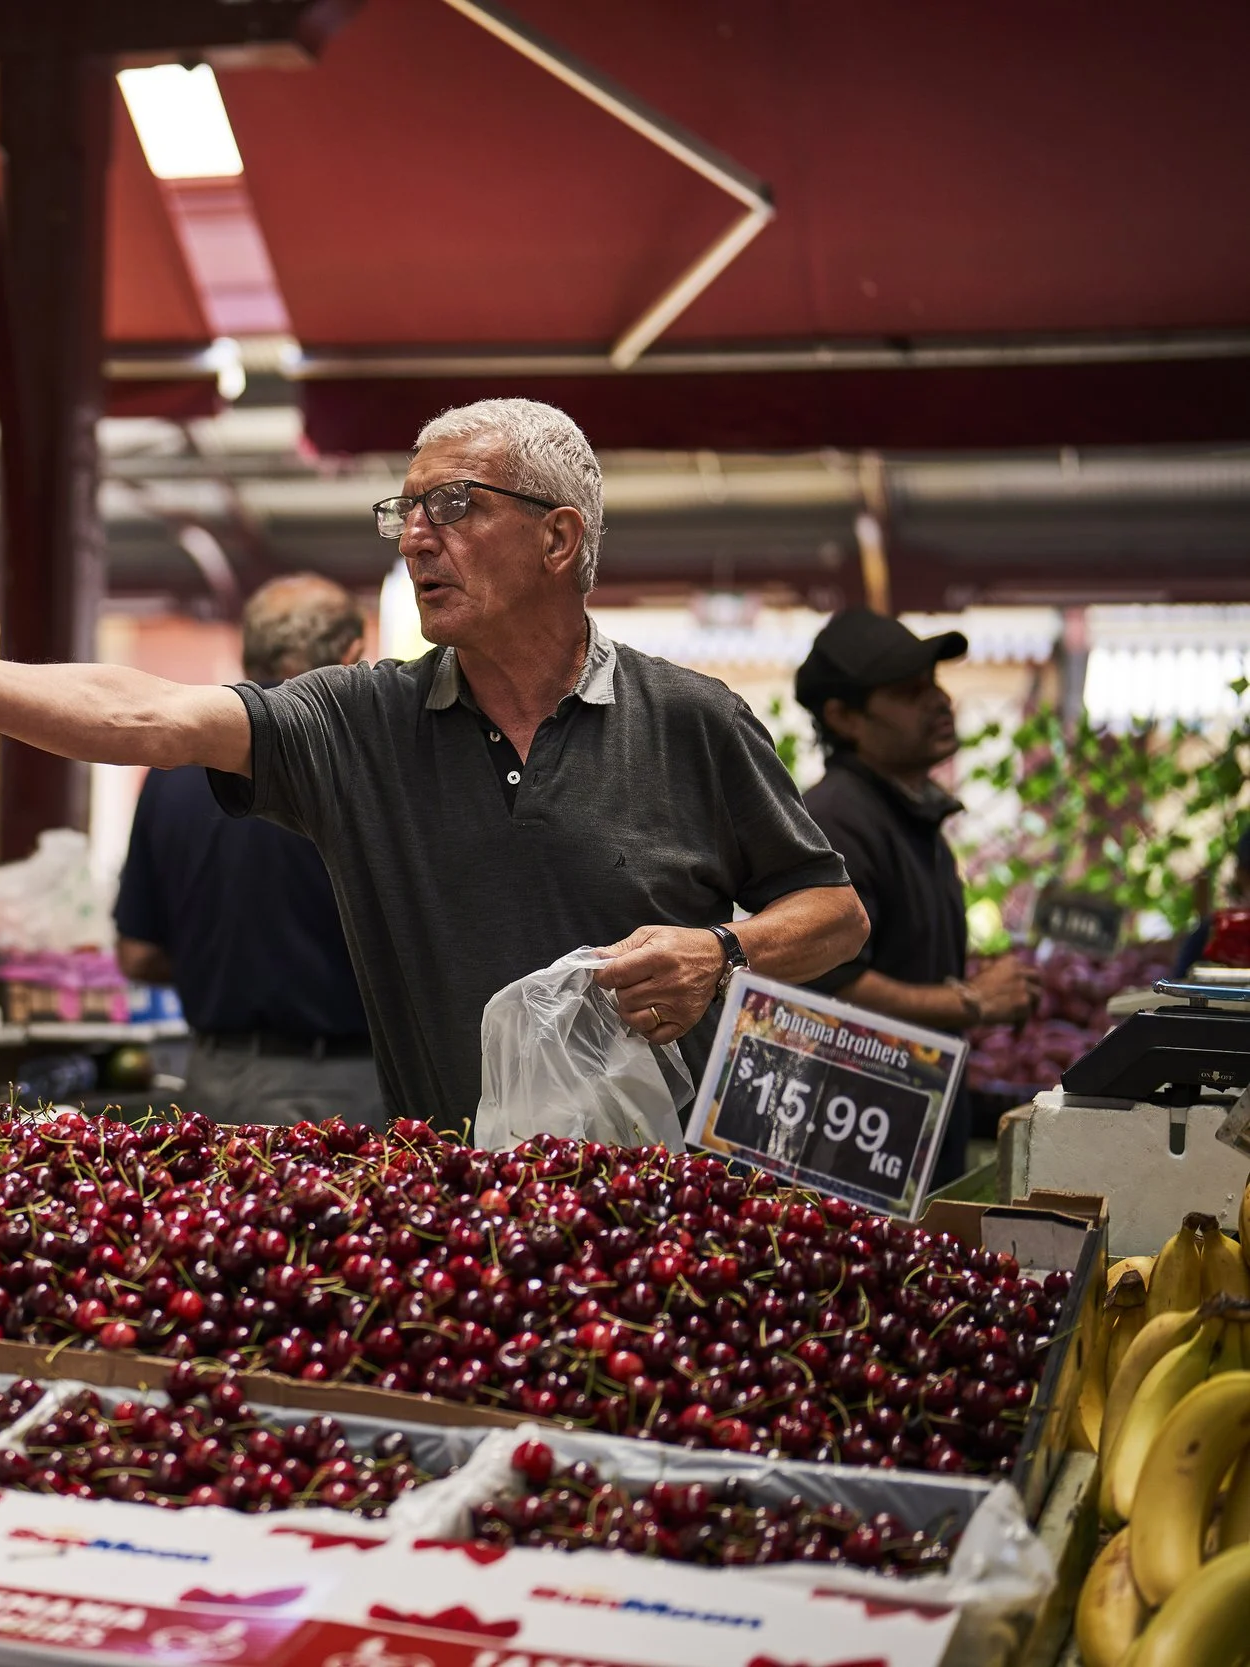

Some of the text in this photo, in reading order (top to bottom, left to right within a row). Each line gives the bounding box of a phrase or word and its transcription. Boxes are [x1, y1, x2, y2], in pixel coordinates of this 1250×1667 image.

[772, 1006, 835, 1045] Fontana
[835, 1026, 910, 1070] Brothers
[868, 1150, 903, 1179] KG
